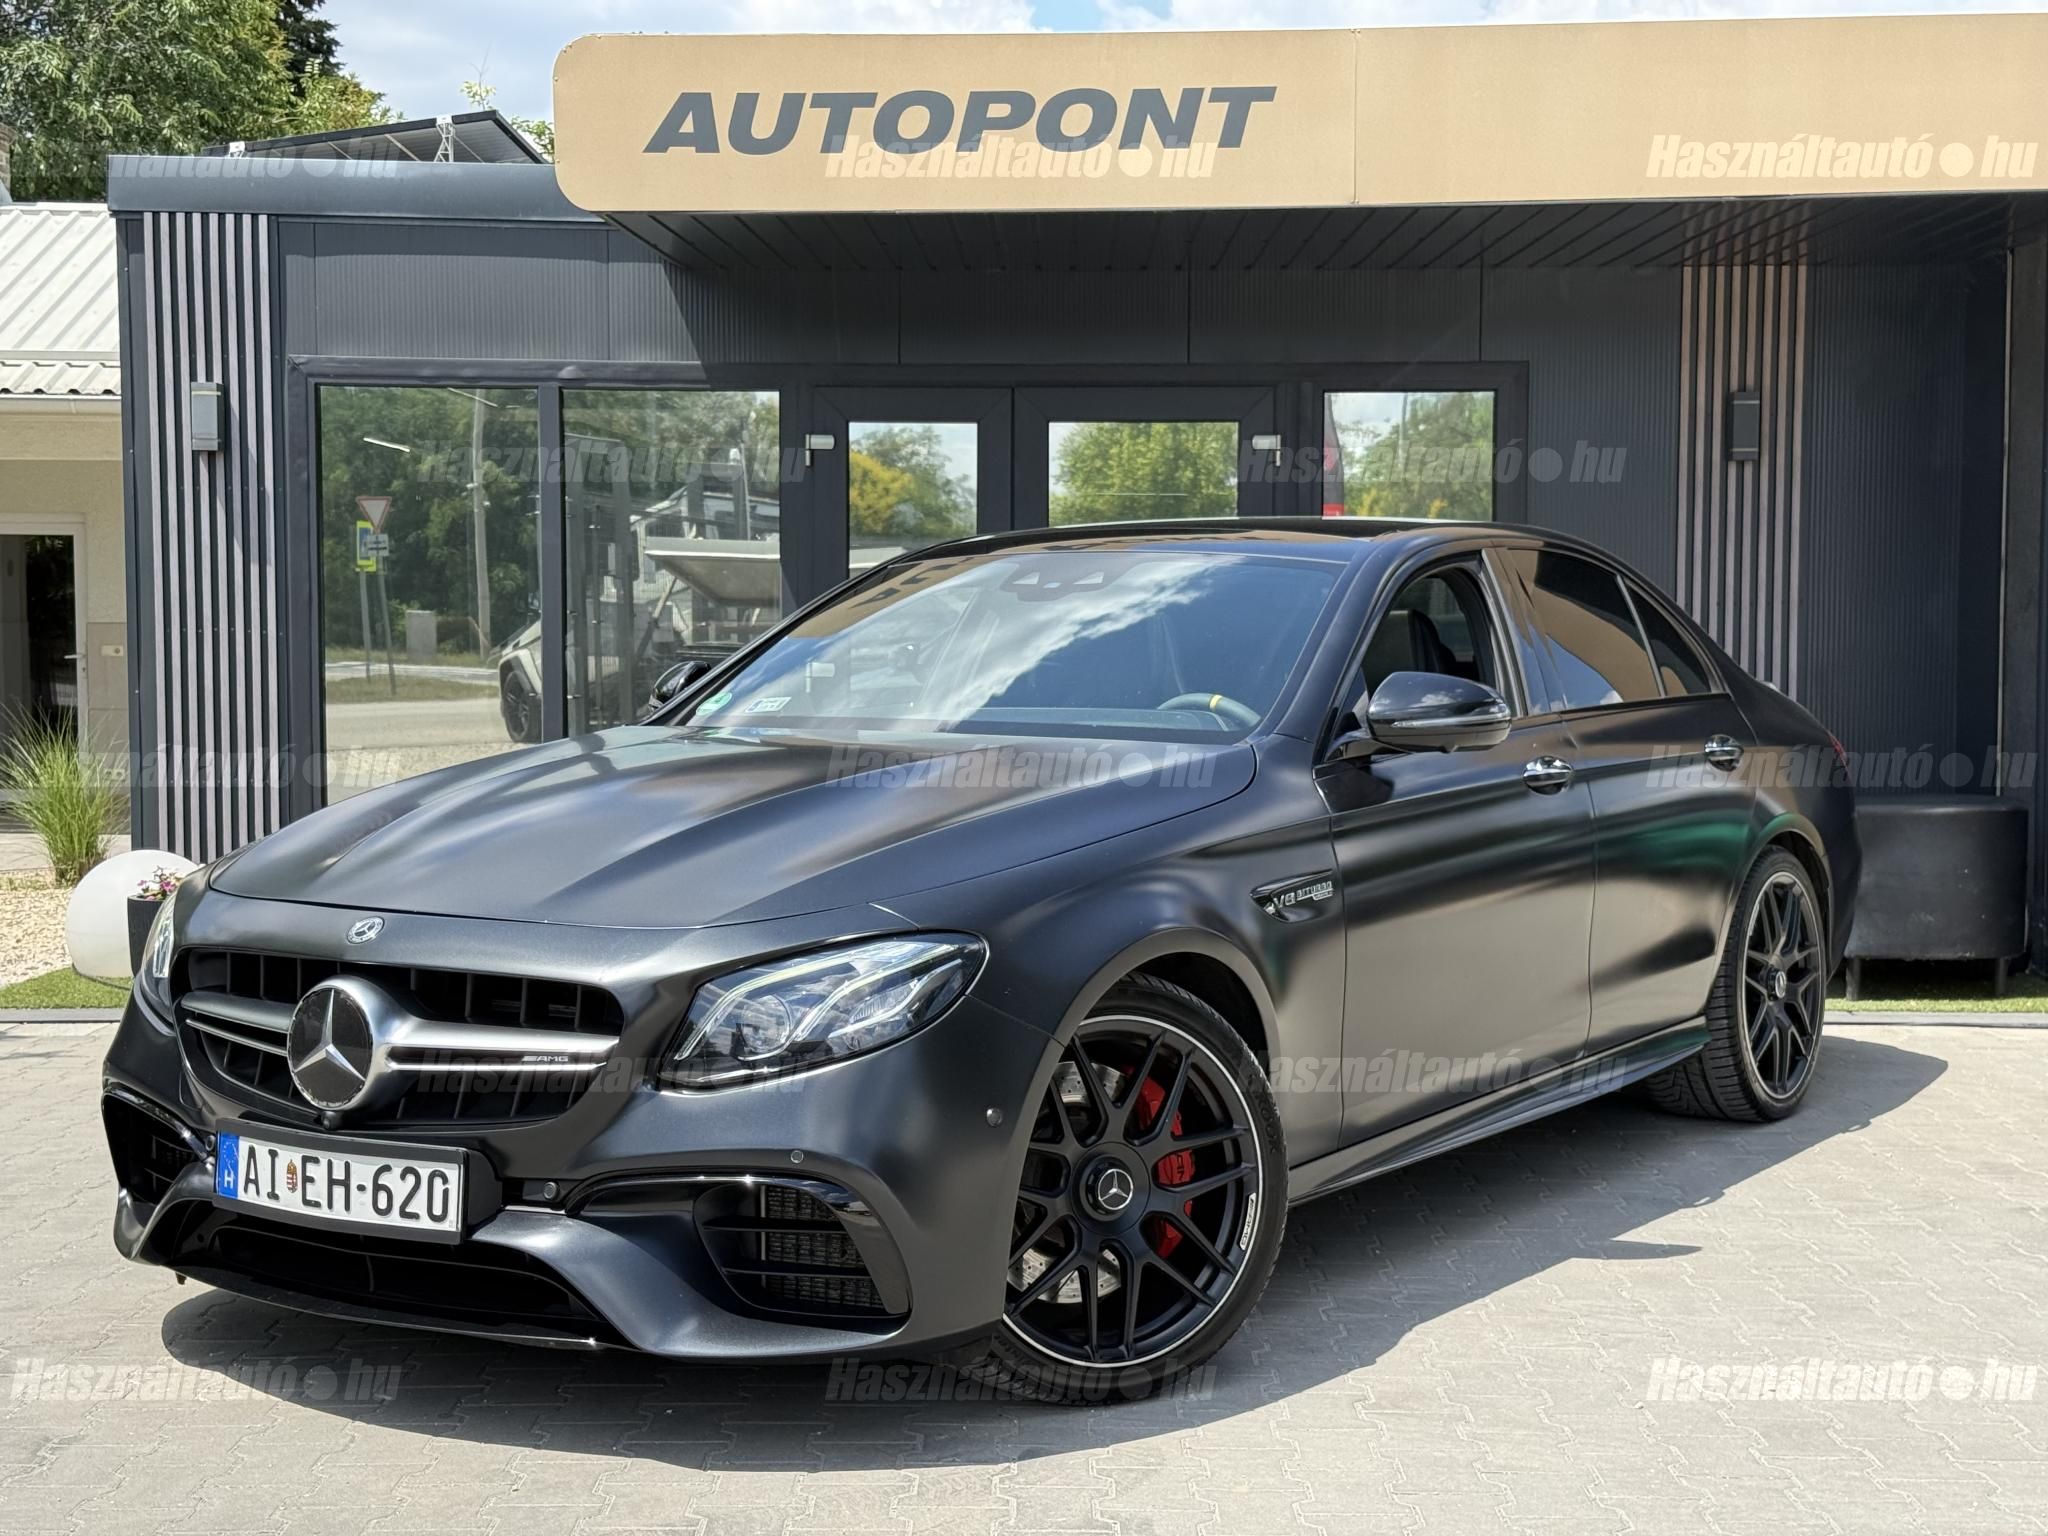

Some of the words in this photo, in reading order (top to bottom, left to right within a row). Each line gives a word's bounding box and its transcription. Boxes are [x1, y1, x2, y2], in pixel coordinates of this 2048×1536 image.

[643, 87, 1277, 154] AUTOPONT
[224, 1170, 235, 1190] H
[243, 1144, 280, 1201] AI
[301, 1154, 450, 1223] EH-620
